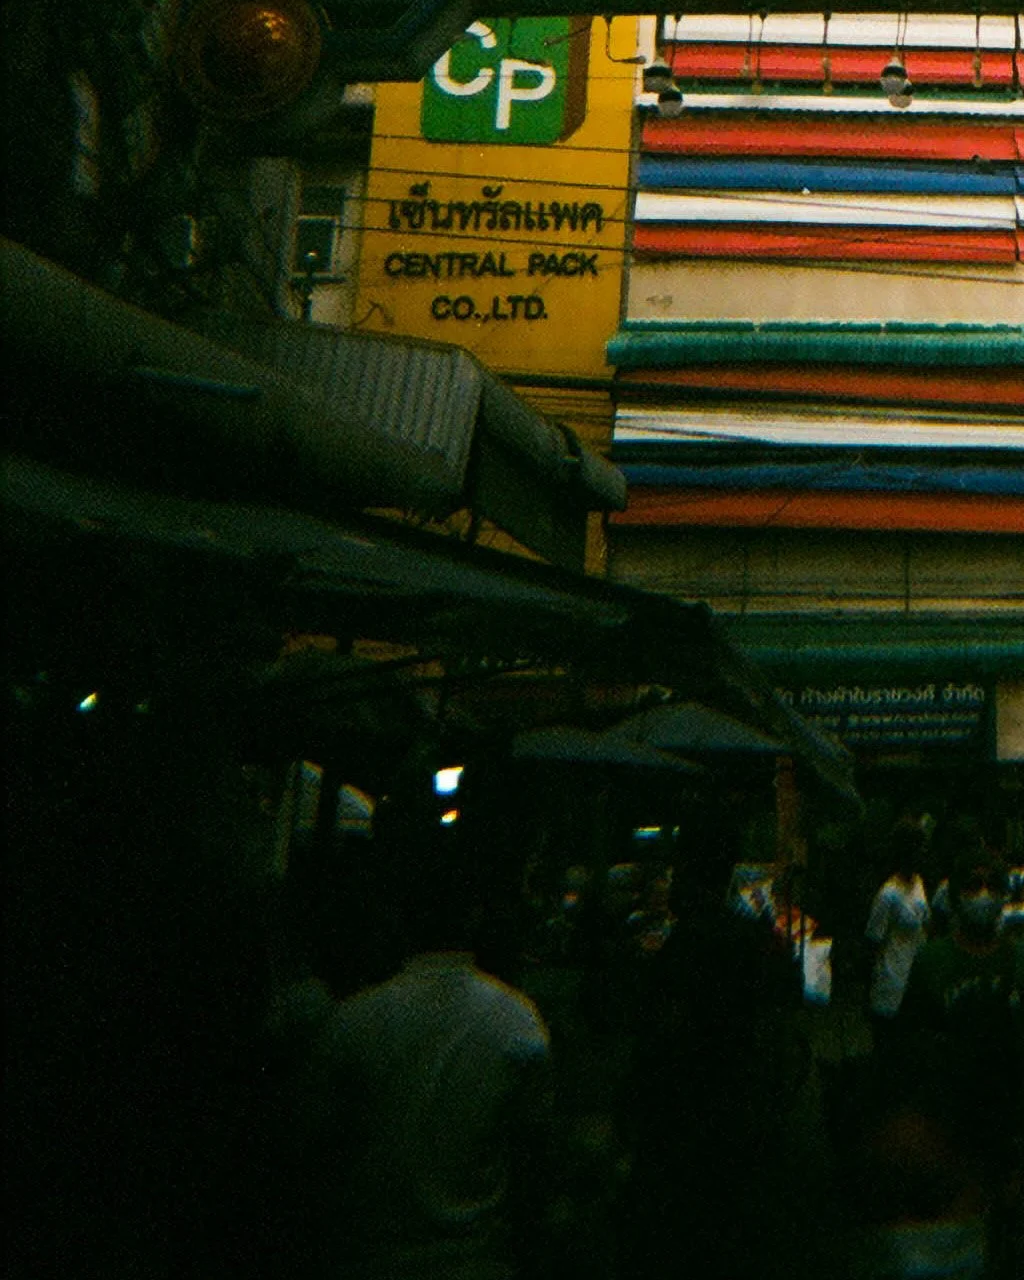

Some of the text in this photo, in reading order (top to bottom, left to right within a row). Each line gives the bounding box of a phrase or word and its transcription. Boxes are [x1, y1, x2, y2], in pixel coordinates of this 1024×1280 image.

[433, 21, 557, 130] CP
[384, 251, 599, 277] CENTRAL PACK
[431, 294, 549, 322] CO.,LTD.
